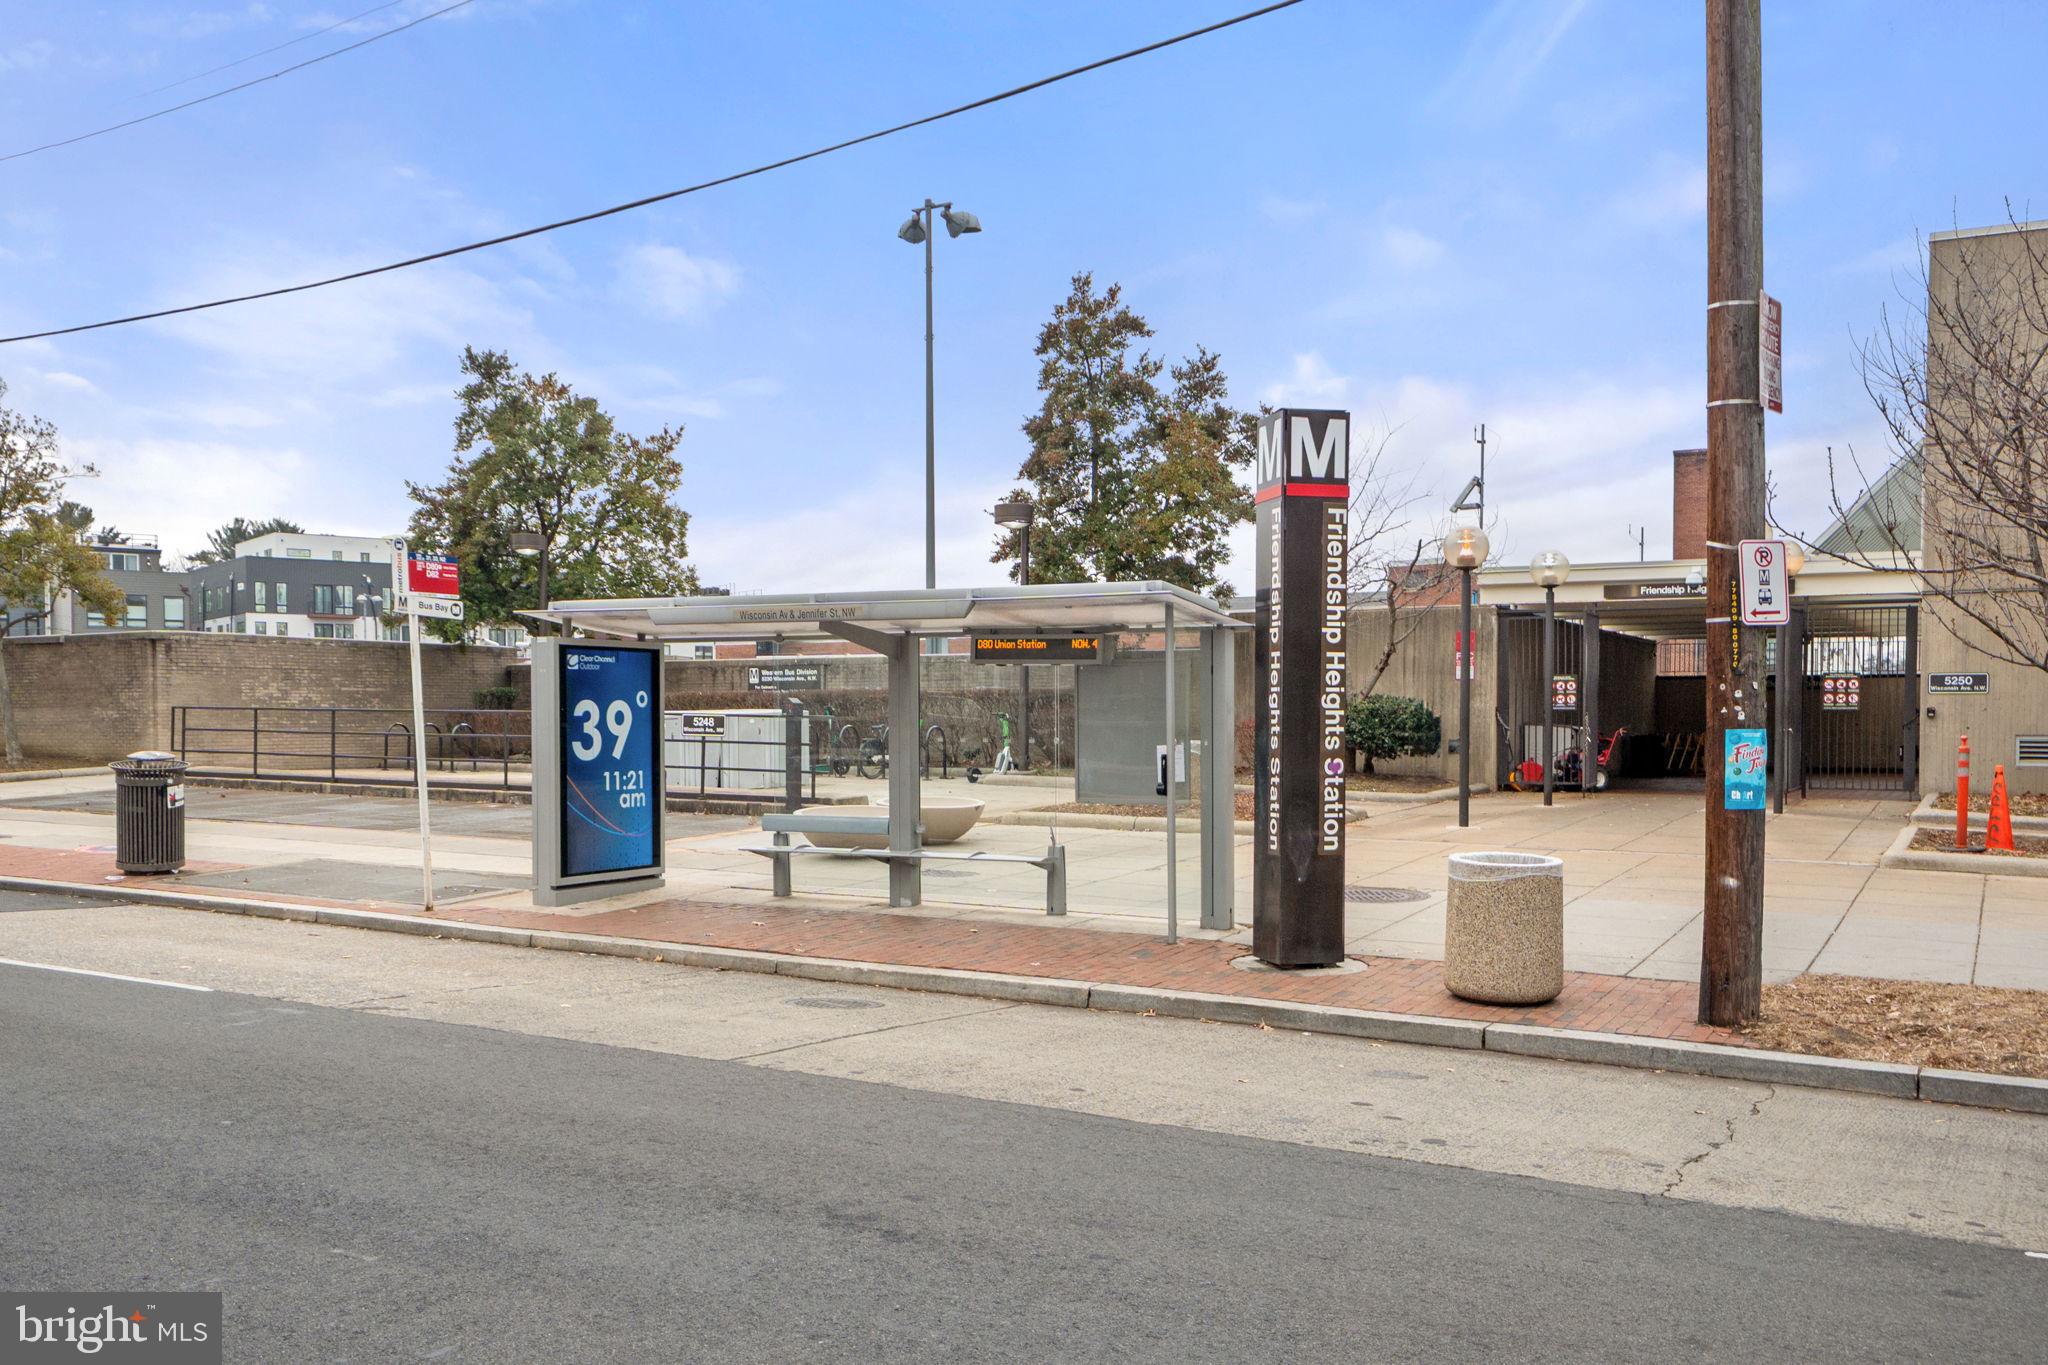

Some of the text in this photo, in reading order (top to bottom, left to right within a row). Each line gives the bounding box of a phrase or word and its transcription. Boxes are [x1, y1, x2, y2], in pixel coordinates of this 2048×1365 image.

[1258, 418, 1281, 484] M
[1290, 416, 1346, 478] M
[1640, 585, 1685, 595] Friendship
[419, 602, 432, 610] Bus
[434, 603, 448, 612] Bay
[740, 610, 777, 620] Wisconsin
[780, 610, 788, 619] Av
[790, 610, 795, 619] &
[798, 609, 827, 619] Jennifer
[842, 608, 856, 617] NW
[994, 639, 1016, 649] Union
[1017, 639, 1046, 649] Station
[595, 655, 616, 663] Channel
[796, 668, 818, 676] Division
[1268, 507, 1280, 850] Friendship Heights Station
[1320, 508, 1347, 850] Friendship Heights Station
[1944, 676, 1973, 685] 5250
[693, 716, 714, 727] 5248
[604, 770, 644, 791] 11:21
[619, 791, 646, 808] am
